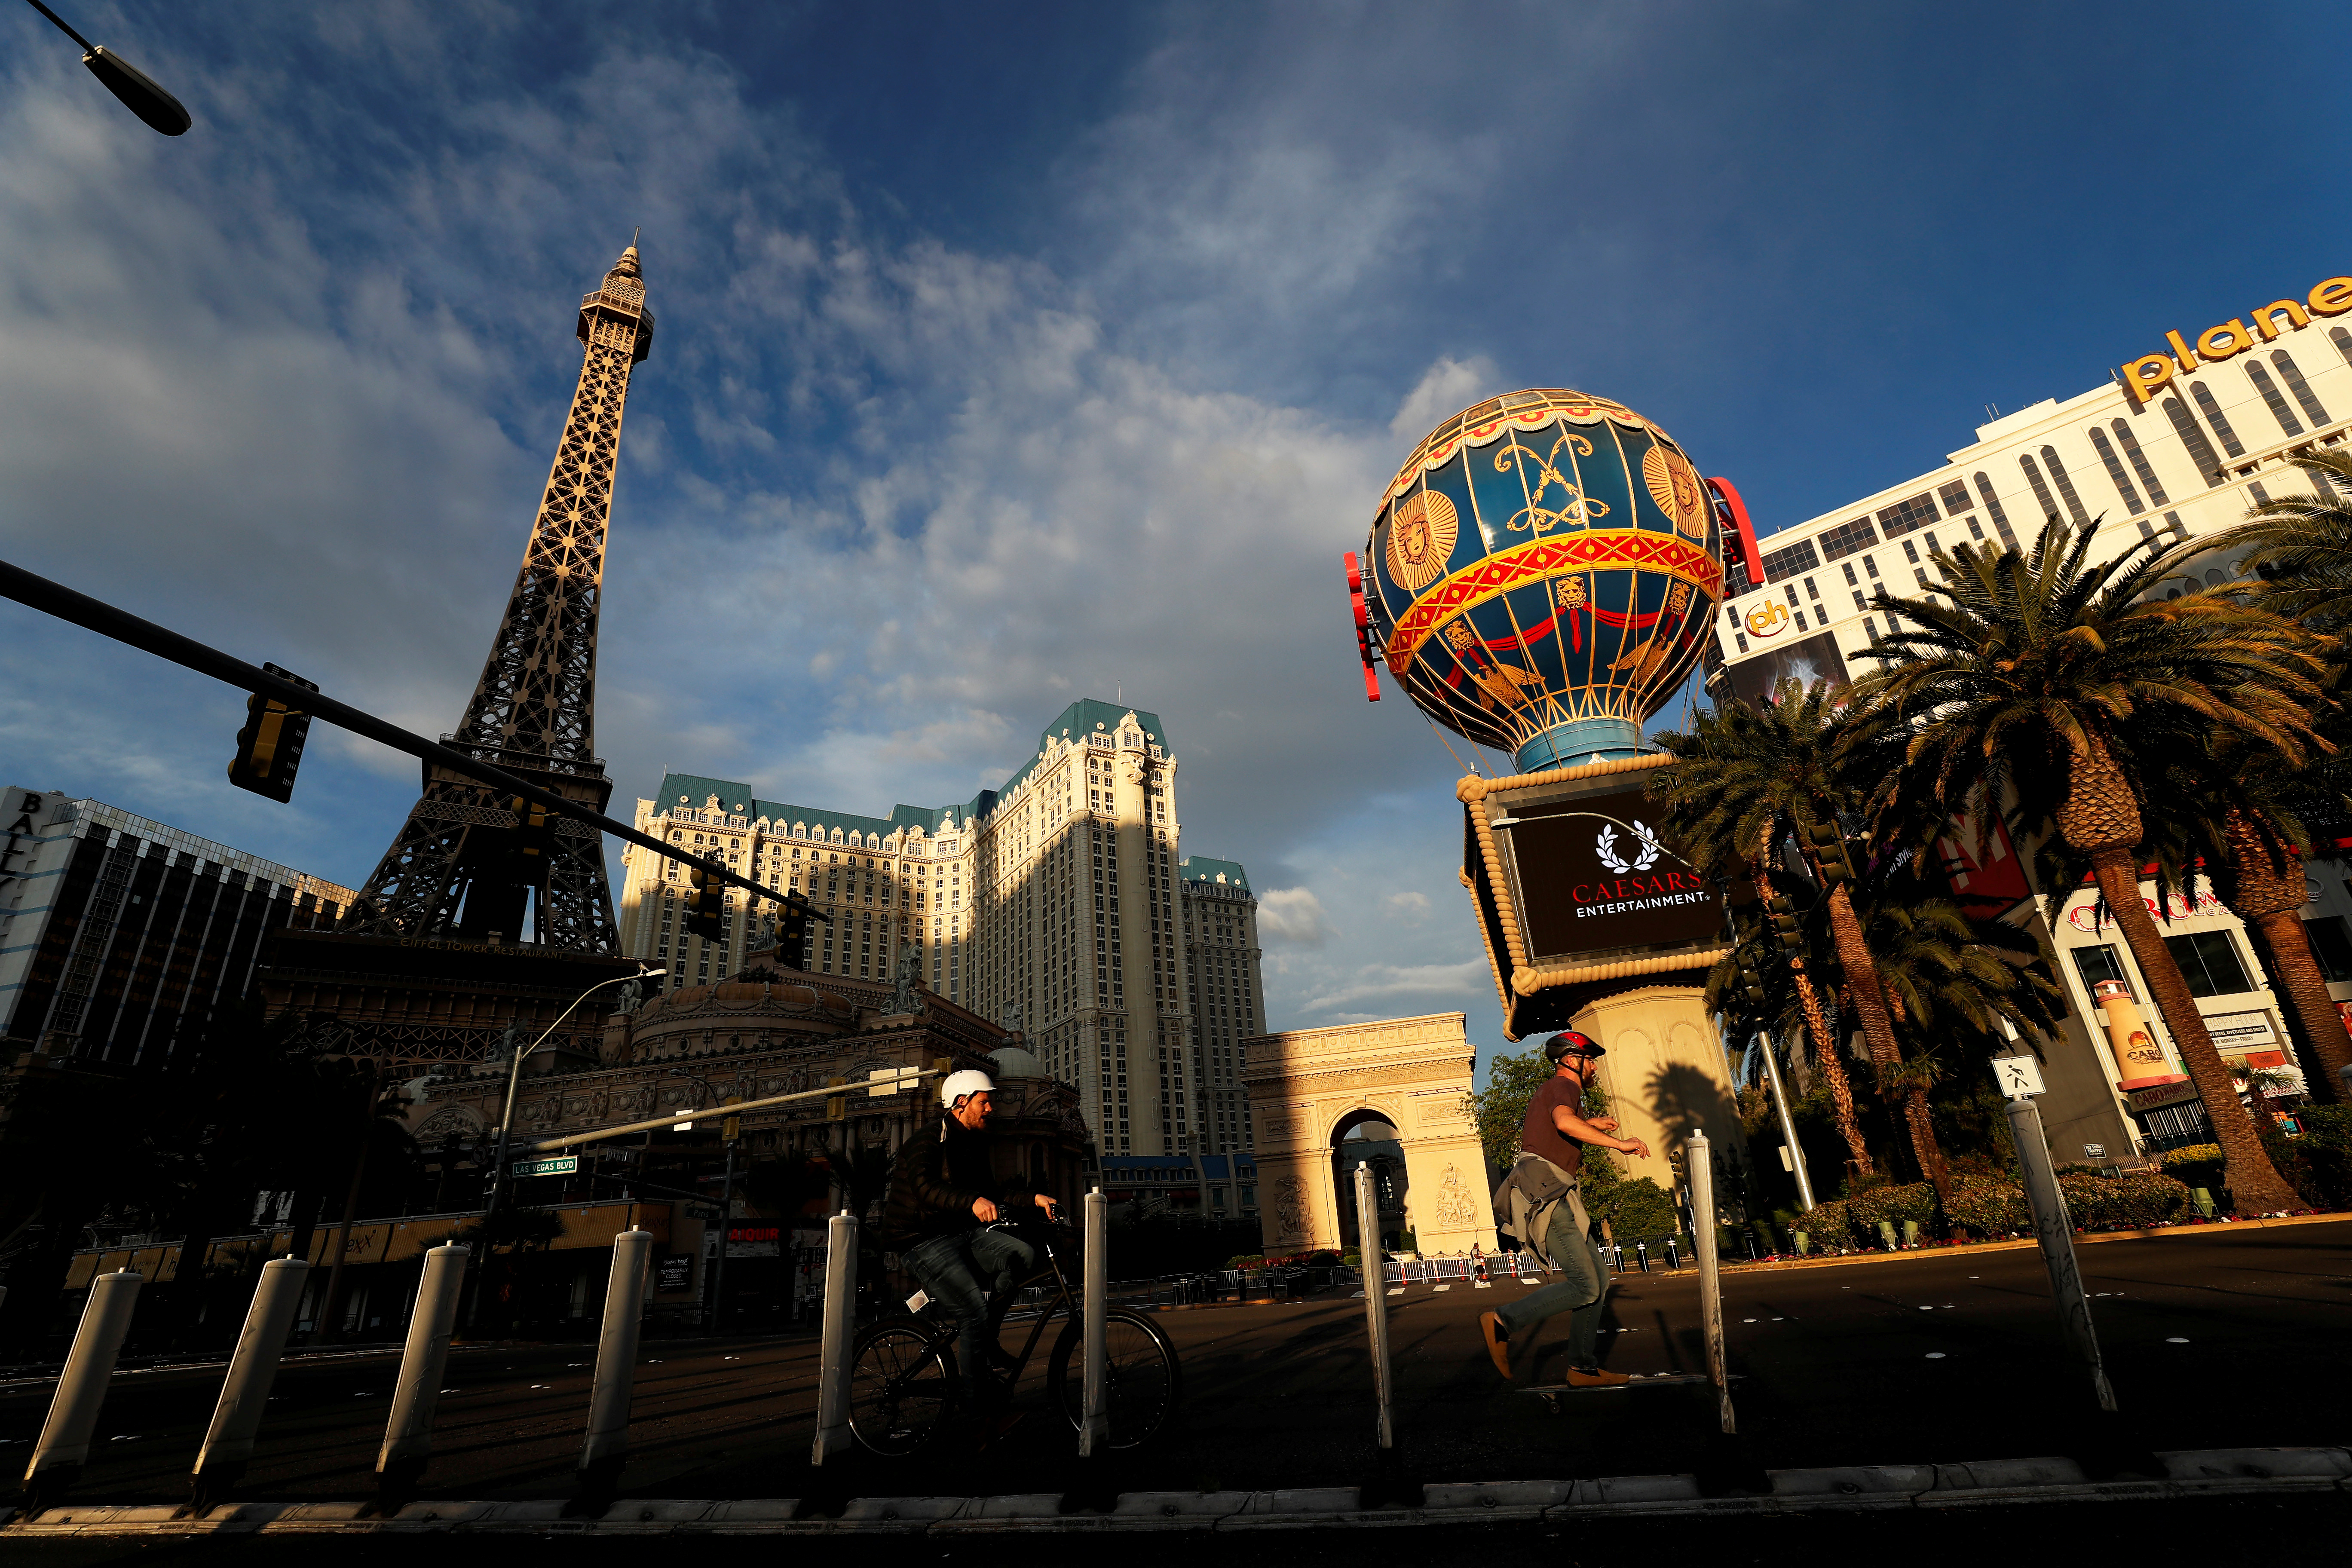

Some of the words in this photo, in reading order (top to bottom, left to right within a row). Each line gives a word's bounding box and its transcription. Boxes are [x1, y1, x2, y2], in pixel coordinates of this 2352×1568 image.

[1749, 600, 1788, 633] ph
[1572, 872, 1701, 903] CAESARS
[1576, 891, 1704, 918] ENTERTAINMENT
[2067, 893, 2194, 931] CBO
[2205, 1017, 2234, 1029] HAPPY
[2235, 1014, 2258, 1026] HOUR
[2127, 1049, 2161, 1060] CABO
[2135, 1088, 2164, 1107] CABO
[2162, 1083, 2184, 1096] WABO
[515, 1165, 529, 1173] LAS
[533, 1162, 554, 1172] VEGAS
[556, 1161, 574, 1170] BLVD
[693, 1209, 709, 1218] Paris
